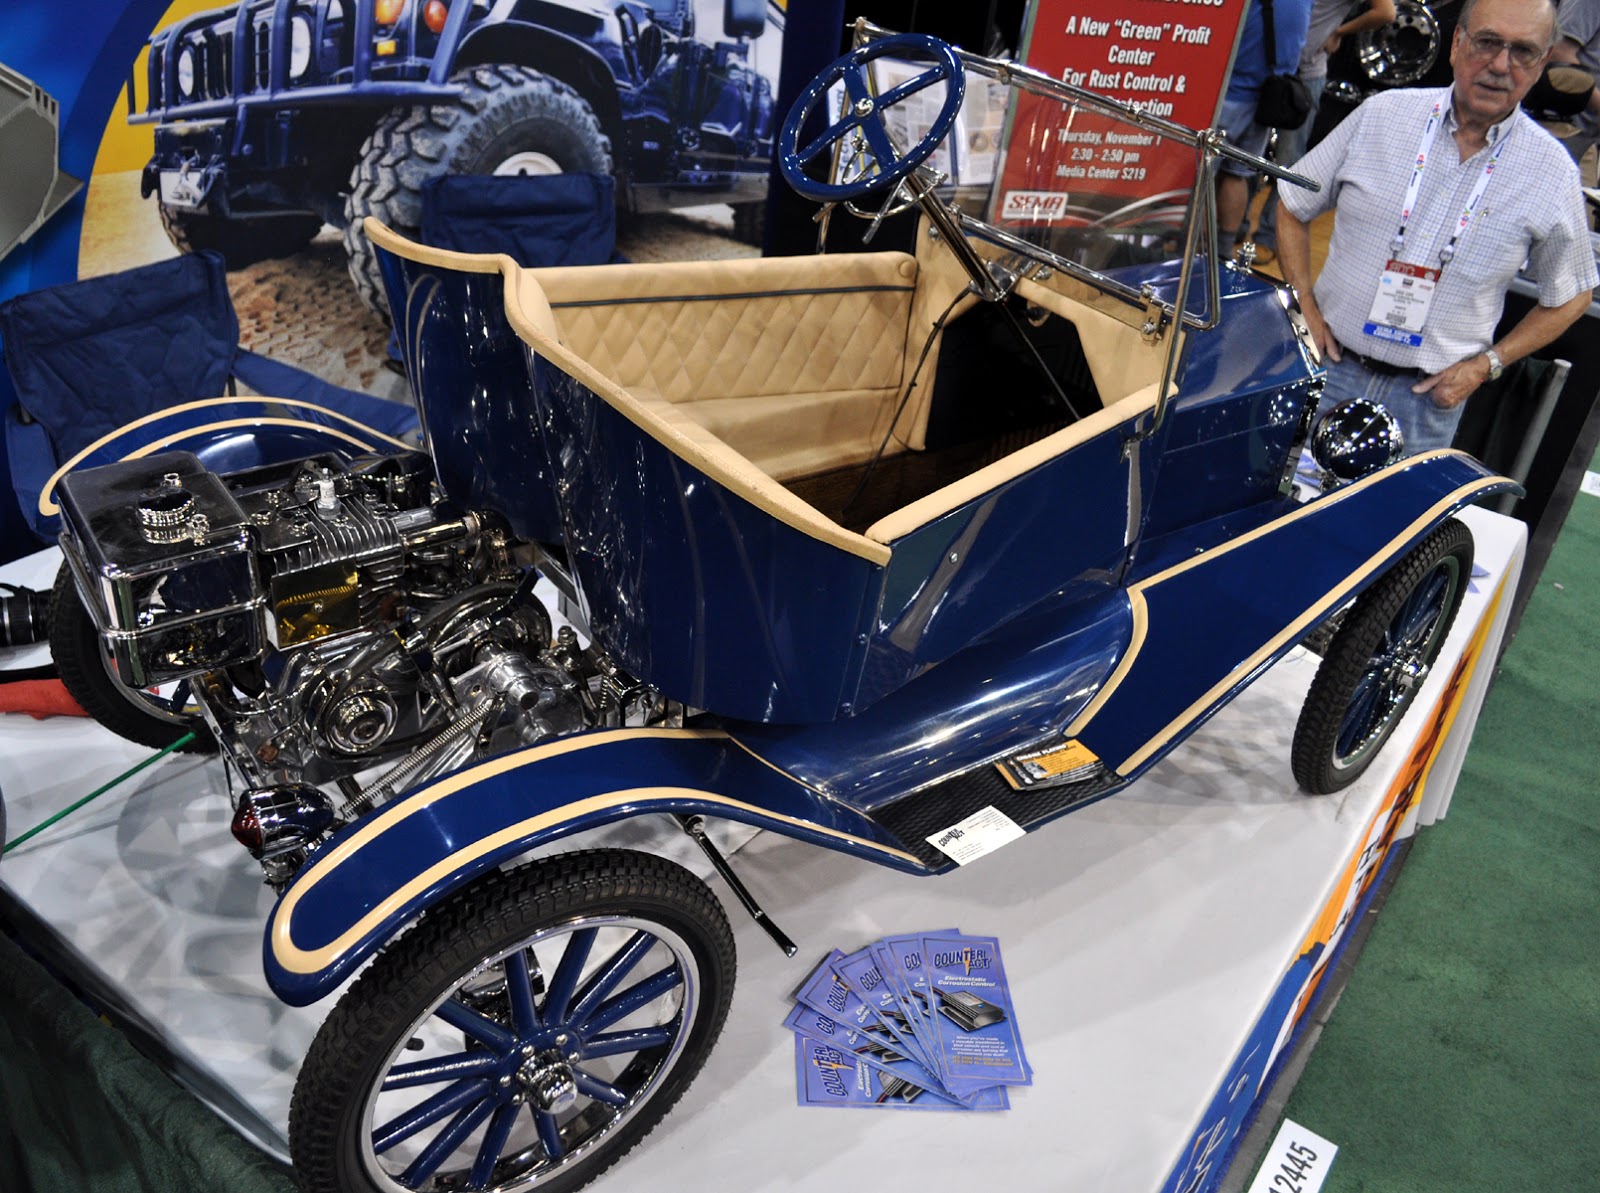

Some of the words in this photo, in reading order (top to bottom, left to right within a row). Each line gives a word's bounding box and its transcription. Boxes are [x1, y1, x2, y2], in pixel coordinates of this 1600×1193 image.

[1065, 16, 1076, 34] A
[1079, 16, 1110, 37] New
[1172, 24, 1212, 44] Profit
[1108, 45, 1155, 65] Center
[1062, 68, 1086, 87] For
[1088, 69, 1121, 89] Rust
[1123, 72, 1174, 92] Control
[1175, 75, 1186, 93] &
[1105, 131, 1154, 146] November
[1071, 147, 1094, 161] 2:30
[1101, 149, 1124, 162] 2:50
[1123, 152, 1140, 165] pm
[1056, 164, 1086, 178] Media
[1087, 165, 1121, 179] Center
[1121, 167, 1147, 180] S219
[1008, 195, 1064, 209] SEMA
[938, 828, 958, 847] COUNTER
[934, 949, 987, 968] COUNTER
[968, 958, 991, 969] ACT
[814, 1046, 848, 1097] COUNTER
[1269, 1141, 1318, 1193] 2445
